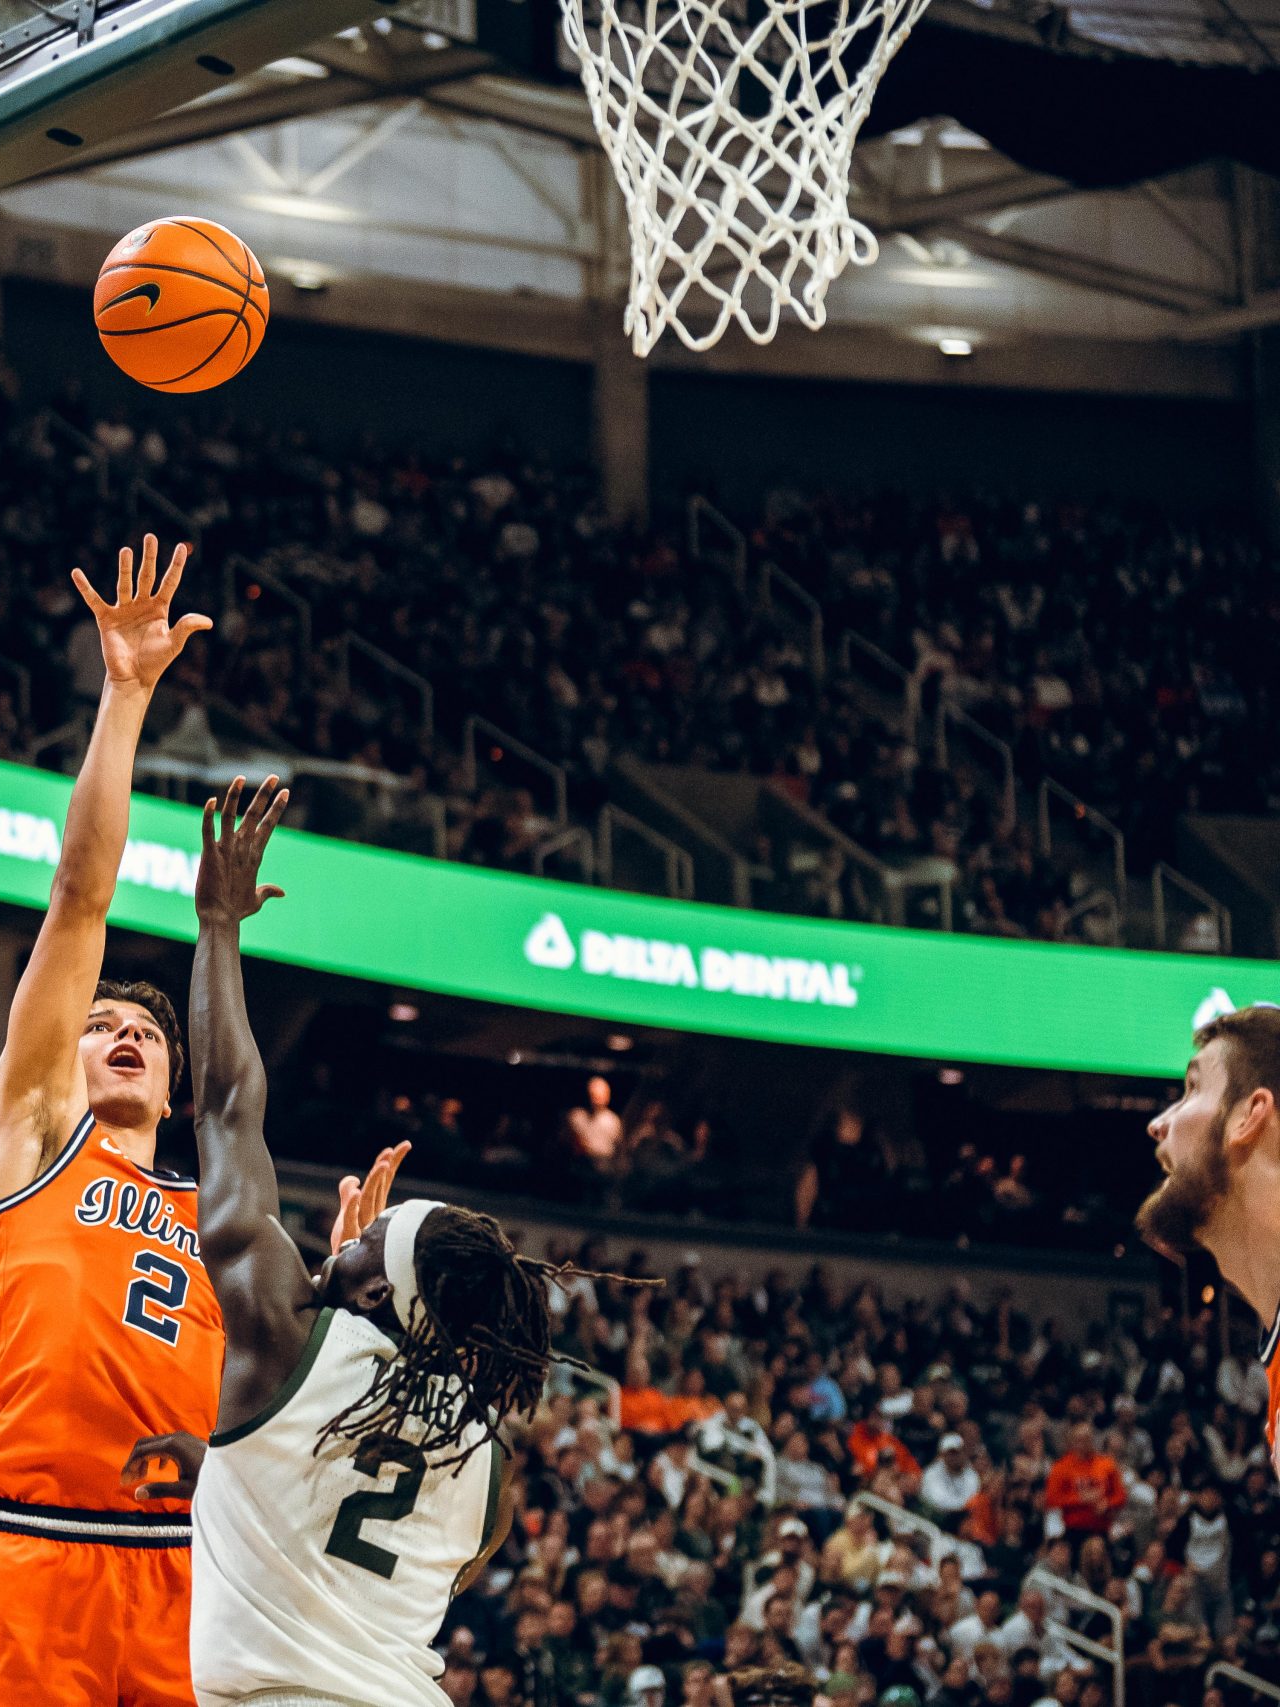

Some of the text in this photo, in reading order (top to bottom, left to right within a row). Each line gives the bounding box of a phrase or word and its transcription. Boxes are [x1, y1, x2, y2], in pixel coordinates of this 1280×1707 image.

[117, 838, 202, 897] NTA
[581, 930, 858, 1008] DELTA DENTAL
[75, 1176, 206, 1266] Illin
[122, 1249, 191, 1348] 2
[323, 1430, 428, 1581] 2
